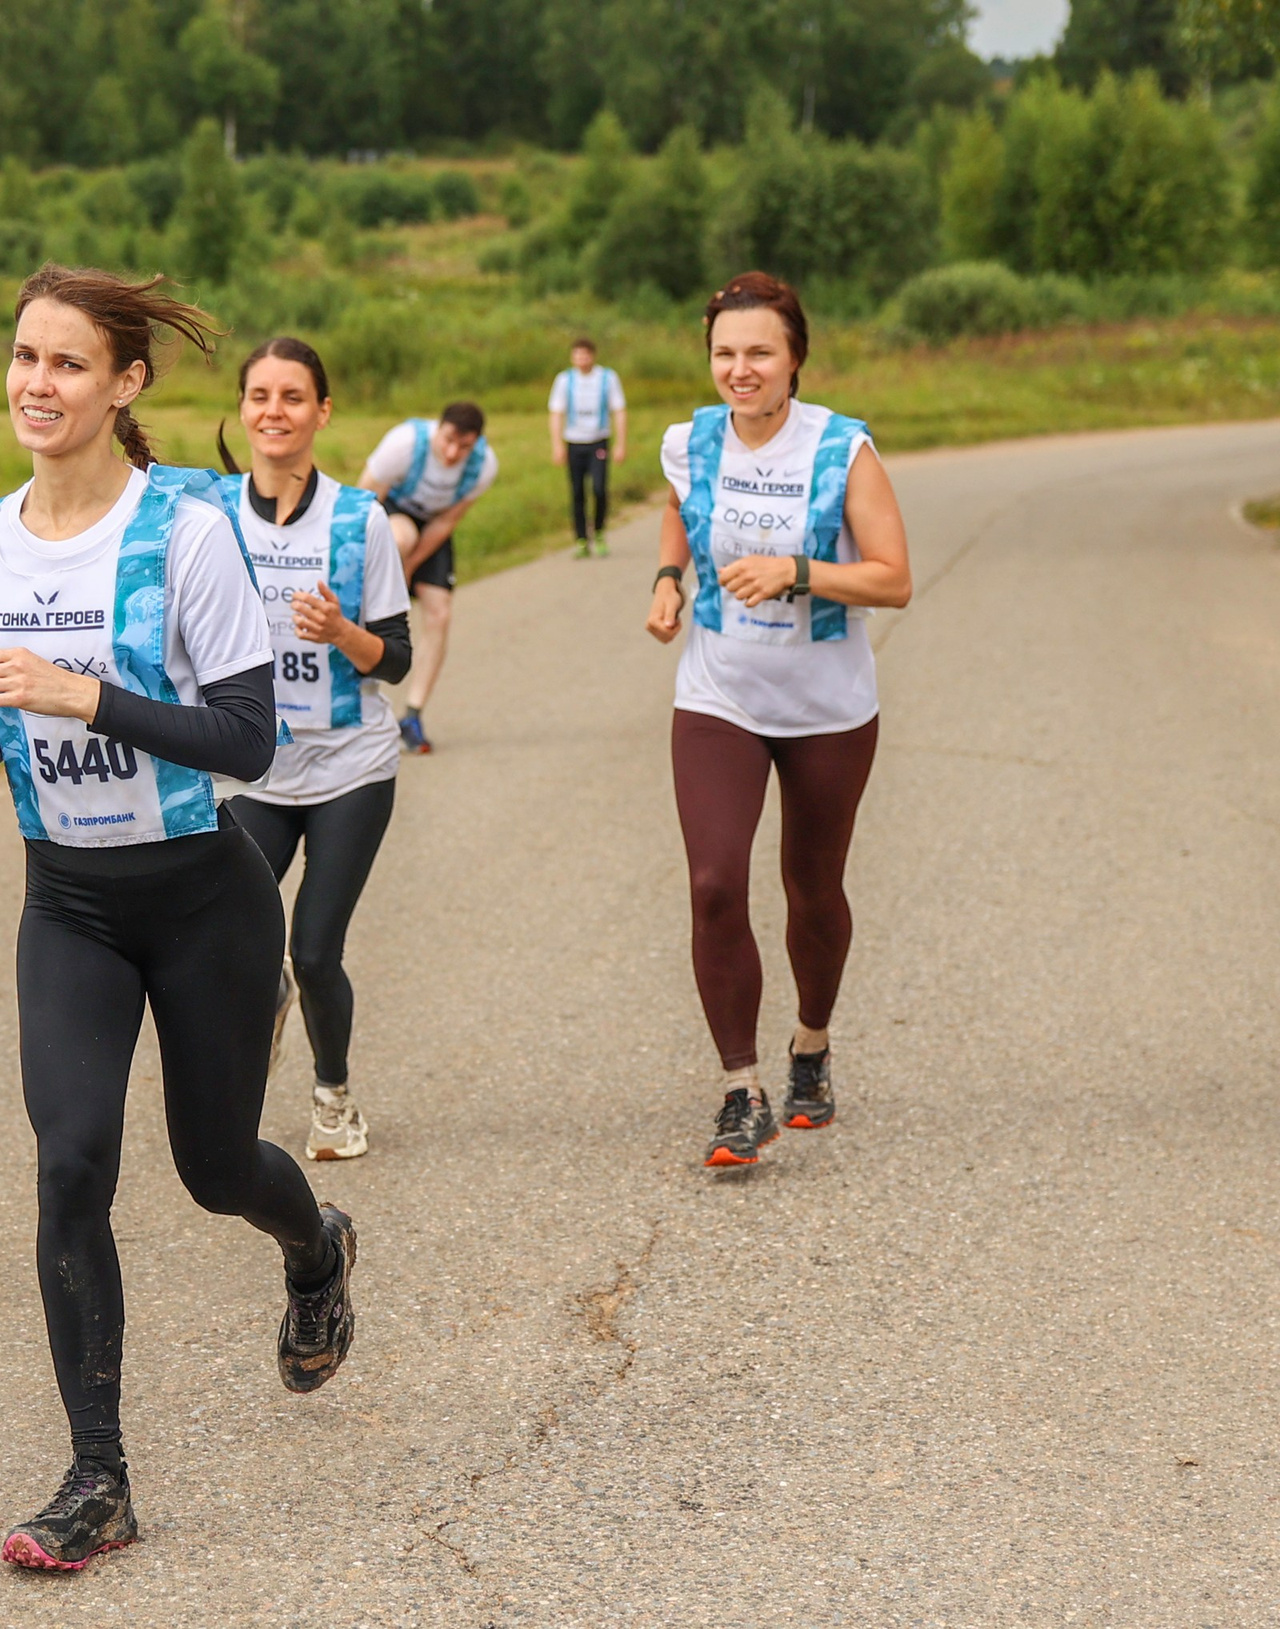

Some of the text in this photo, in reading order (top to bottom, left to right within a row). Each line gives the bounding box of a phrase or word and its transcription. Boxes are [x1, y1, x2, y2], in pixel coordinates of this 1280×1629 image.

[722, 476, 804, 494] ГОНКА ГЕРОЕВ
[278, 555, 323, 566] ГЕРОЕВ
[45, 609, 105, 626] ГЕРОЕВ
[33, 737, 138, 785] 5440
[73, 811, 136, 827] ГАЗПРОМБАНК
